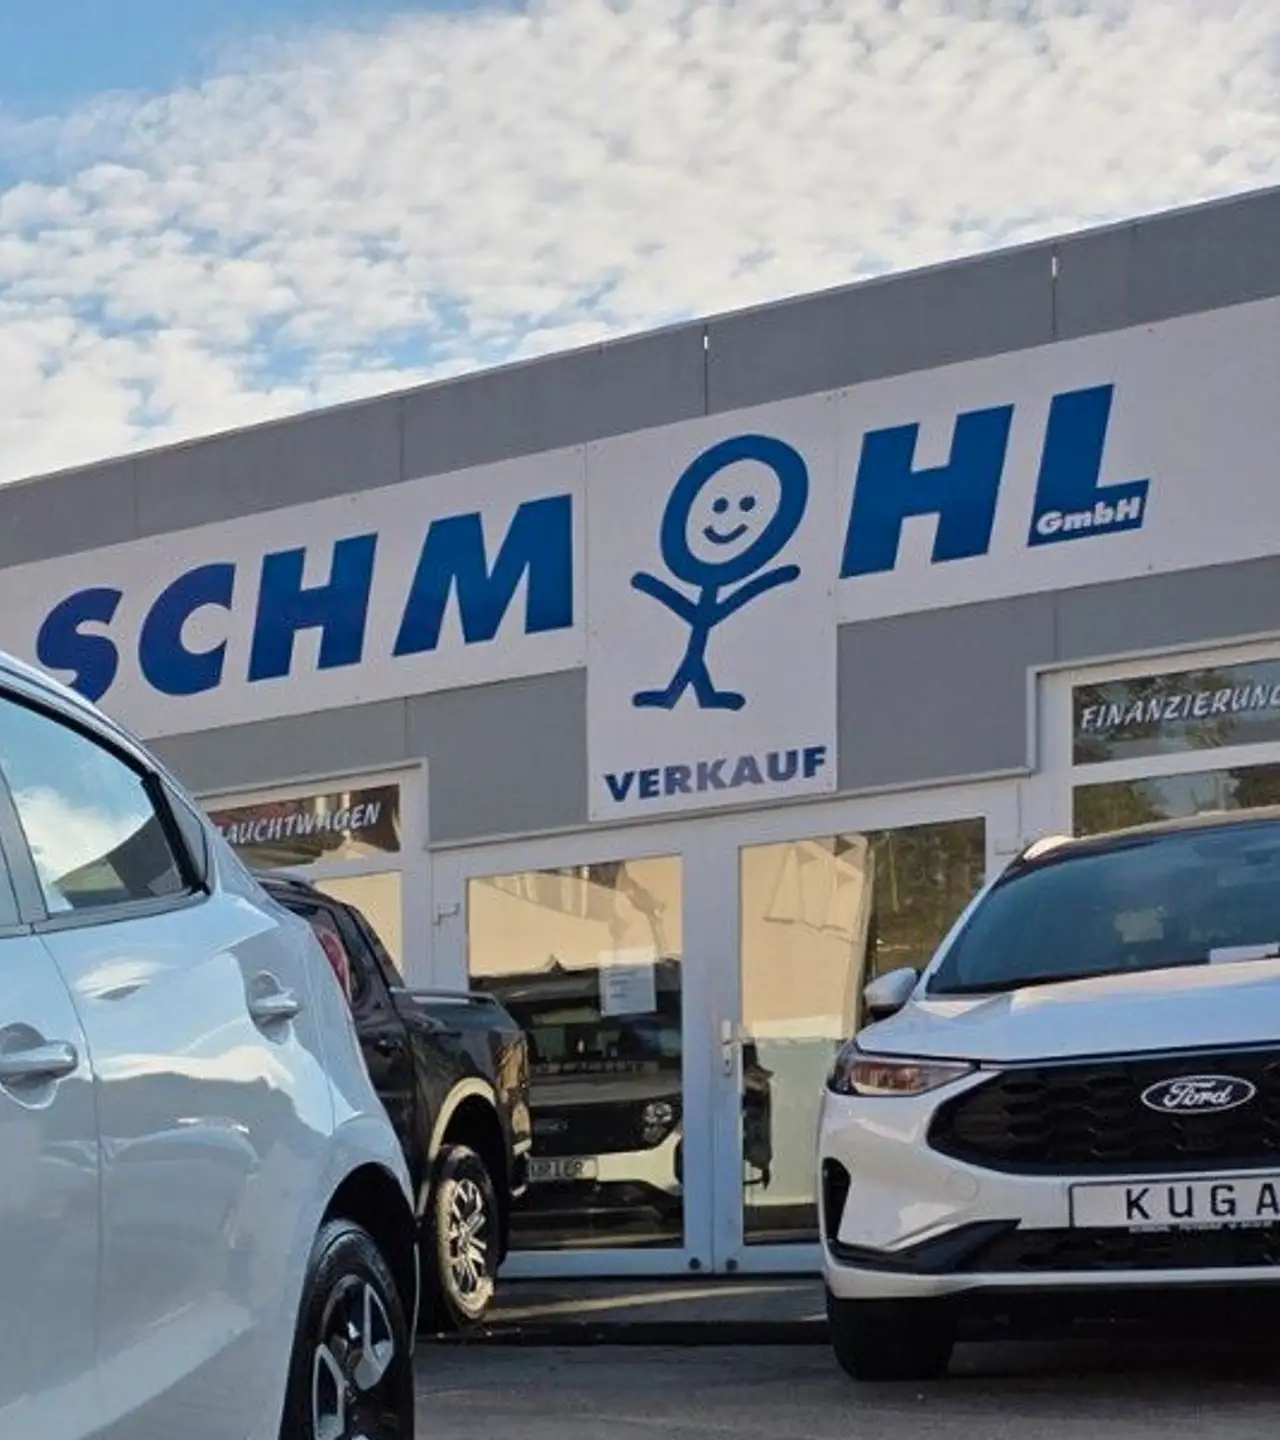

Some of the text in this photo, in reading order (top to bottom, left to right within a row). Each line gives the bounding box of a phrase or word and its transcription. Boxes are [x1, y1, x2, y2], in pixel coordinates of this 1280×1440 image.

[1036, 496, 1142, 536] GmbH
[603, 745, 828, 803] VERKAUF
[218, 802, 382, 845] AUCHTWAGEN
[1164, 1080, 1234, 1108] Ford
[1125, 1182, 1280, 1221] KUGA
